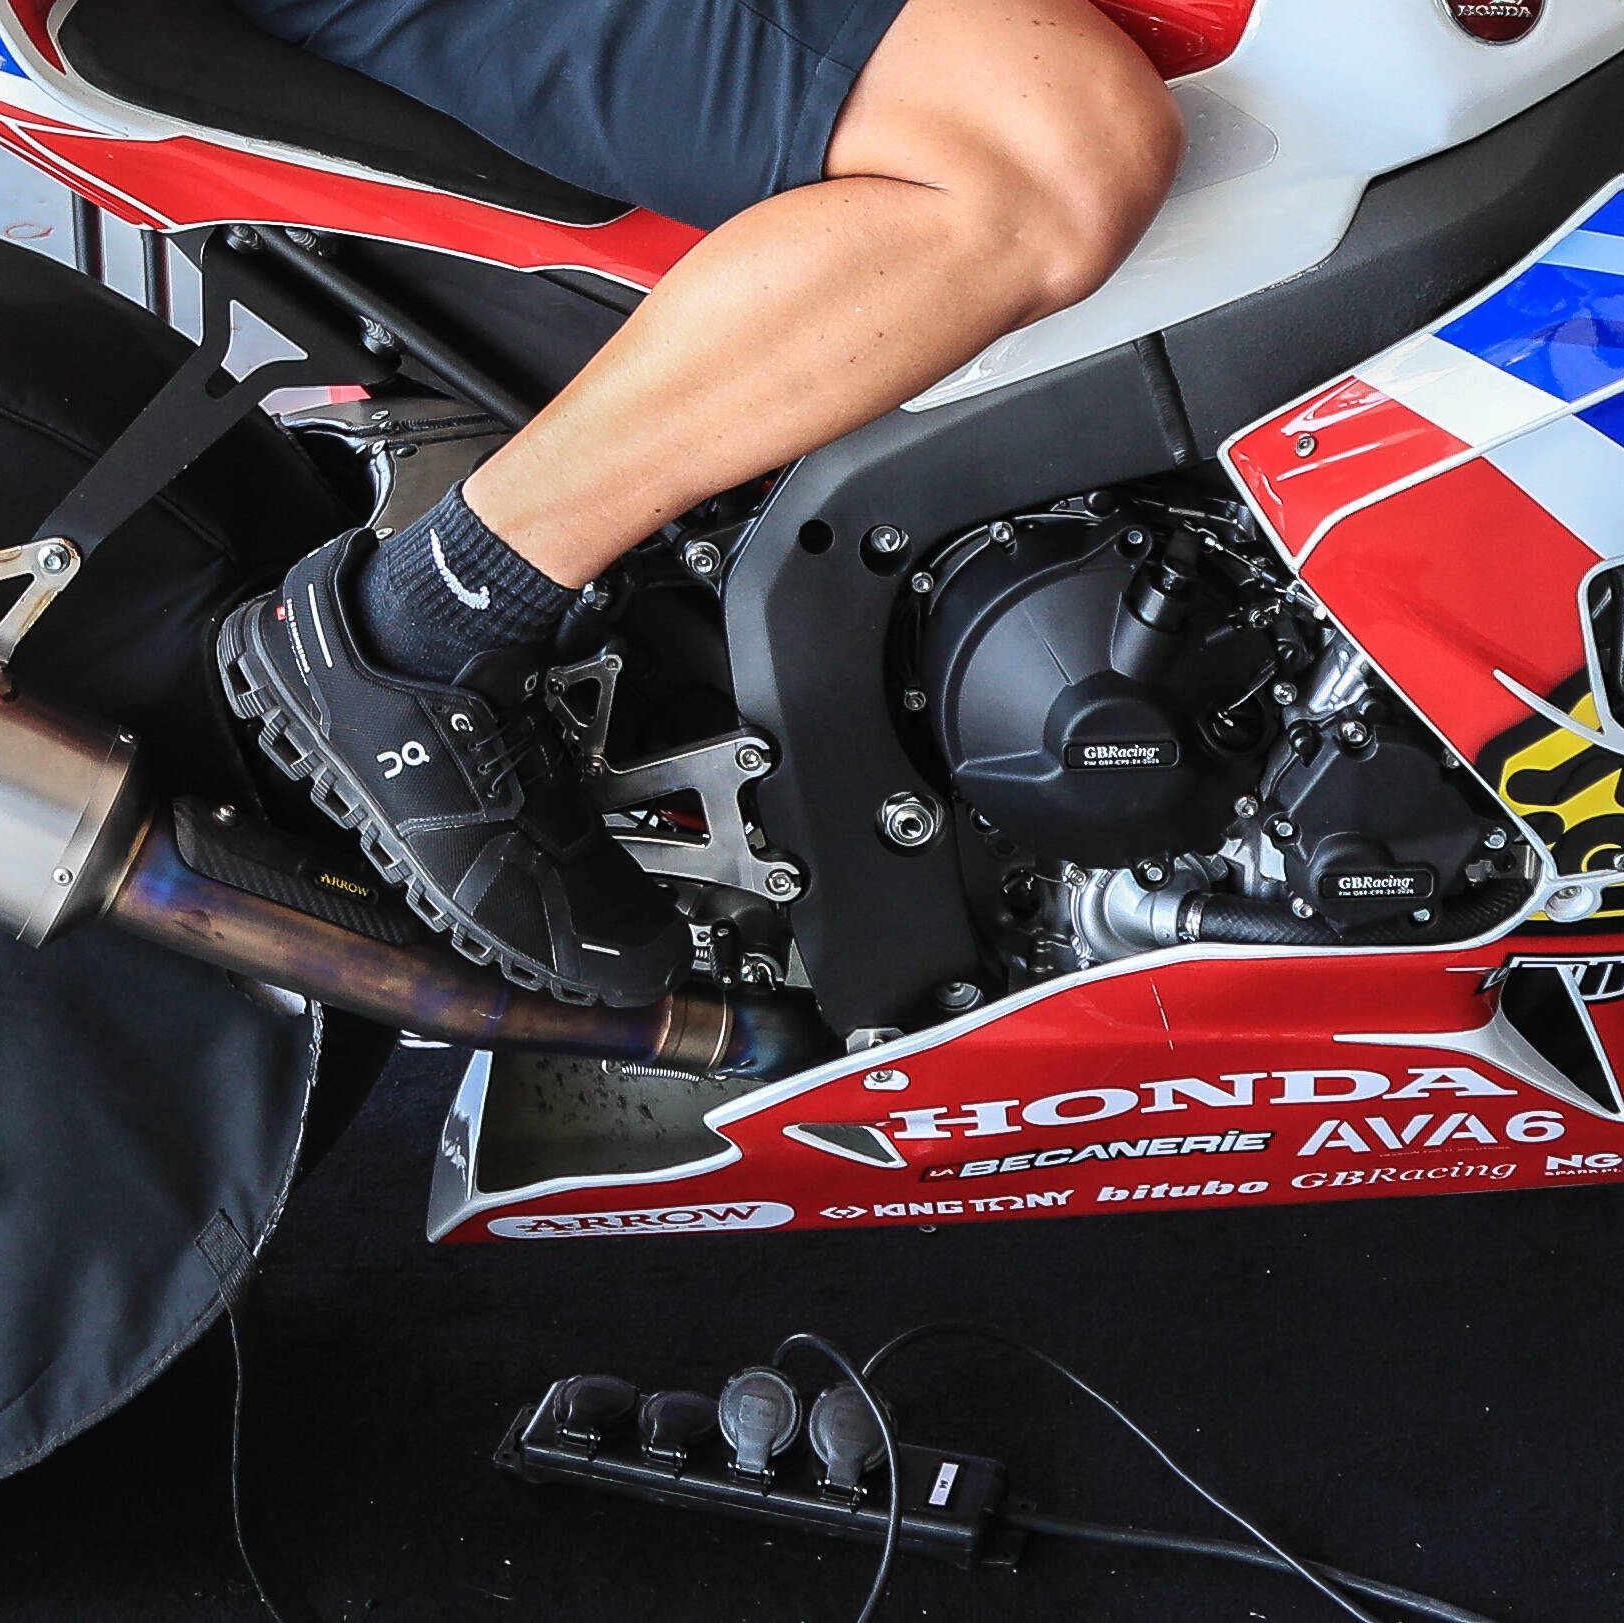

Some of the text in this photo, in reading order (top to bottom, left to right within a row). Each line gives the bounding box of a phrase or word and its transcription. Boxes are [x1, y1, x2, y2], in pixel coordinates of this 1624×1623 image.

[1457, 4, 1533, 18] HONDA
[1084, 745, 1159, 760] GBRacing
[320, 873, 370, 897] ARROW
[1338, 875, 1414, 890] GBRacing
[890, 1066, 1519, 1140] HONDA
[1291, 1161, 1518, 1191] GBRacing
[1096, 1178, 1269, 1202] bitubo
[873, 1189, 1075, 1218] KING TONY
[517, 1204, 762, 1234] ARROW
